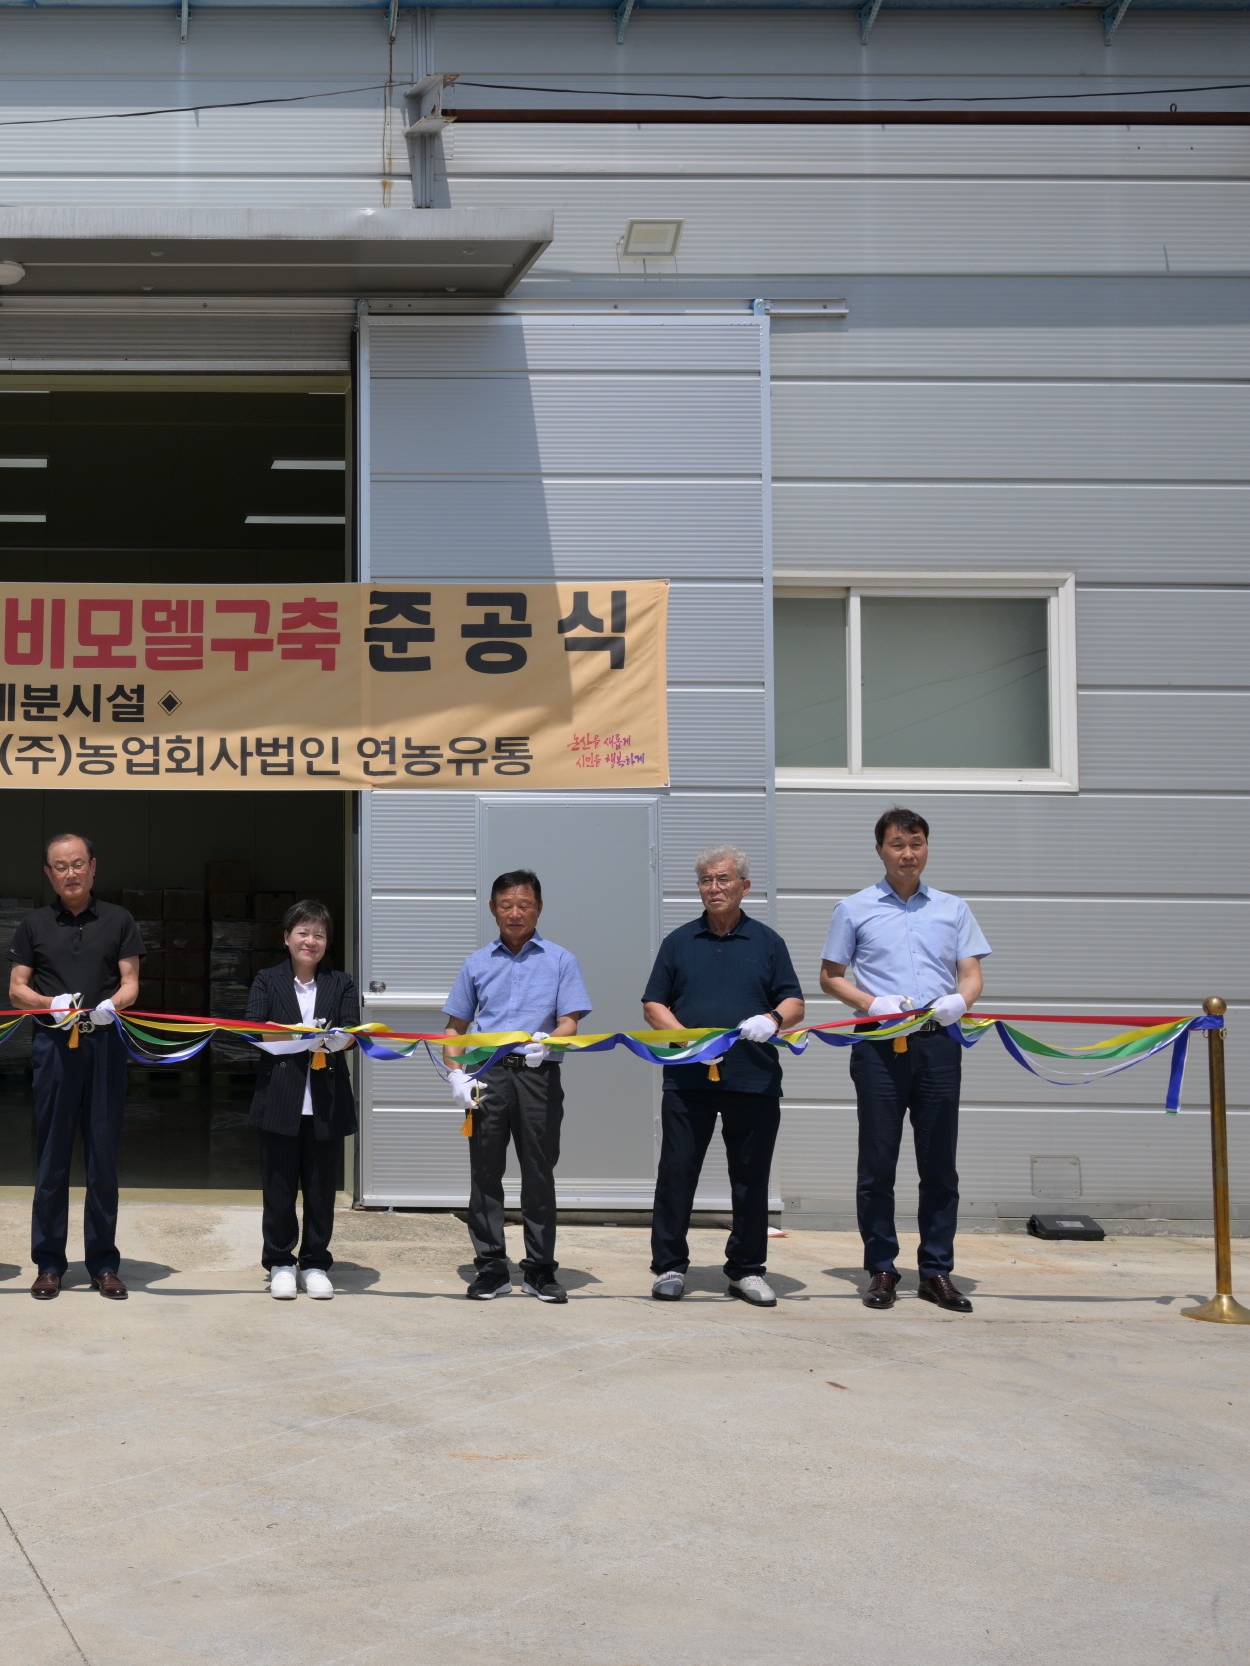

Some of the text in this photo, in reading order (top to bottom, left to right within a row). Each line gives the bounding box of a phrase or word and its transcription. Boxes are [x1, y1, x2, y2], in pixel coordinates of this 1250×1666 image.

[567, 733, 631, 751] 논산을 새롭게
[357, 736, 534, 777] 연농유통
[576, 751, 645, 768] 시민을 행복하게
